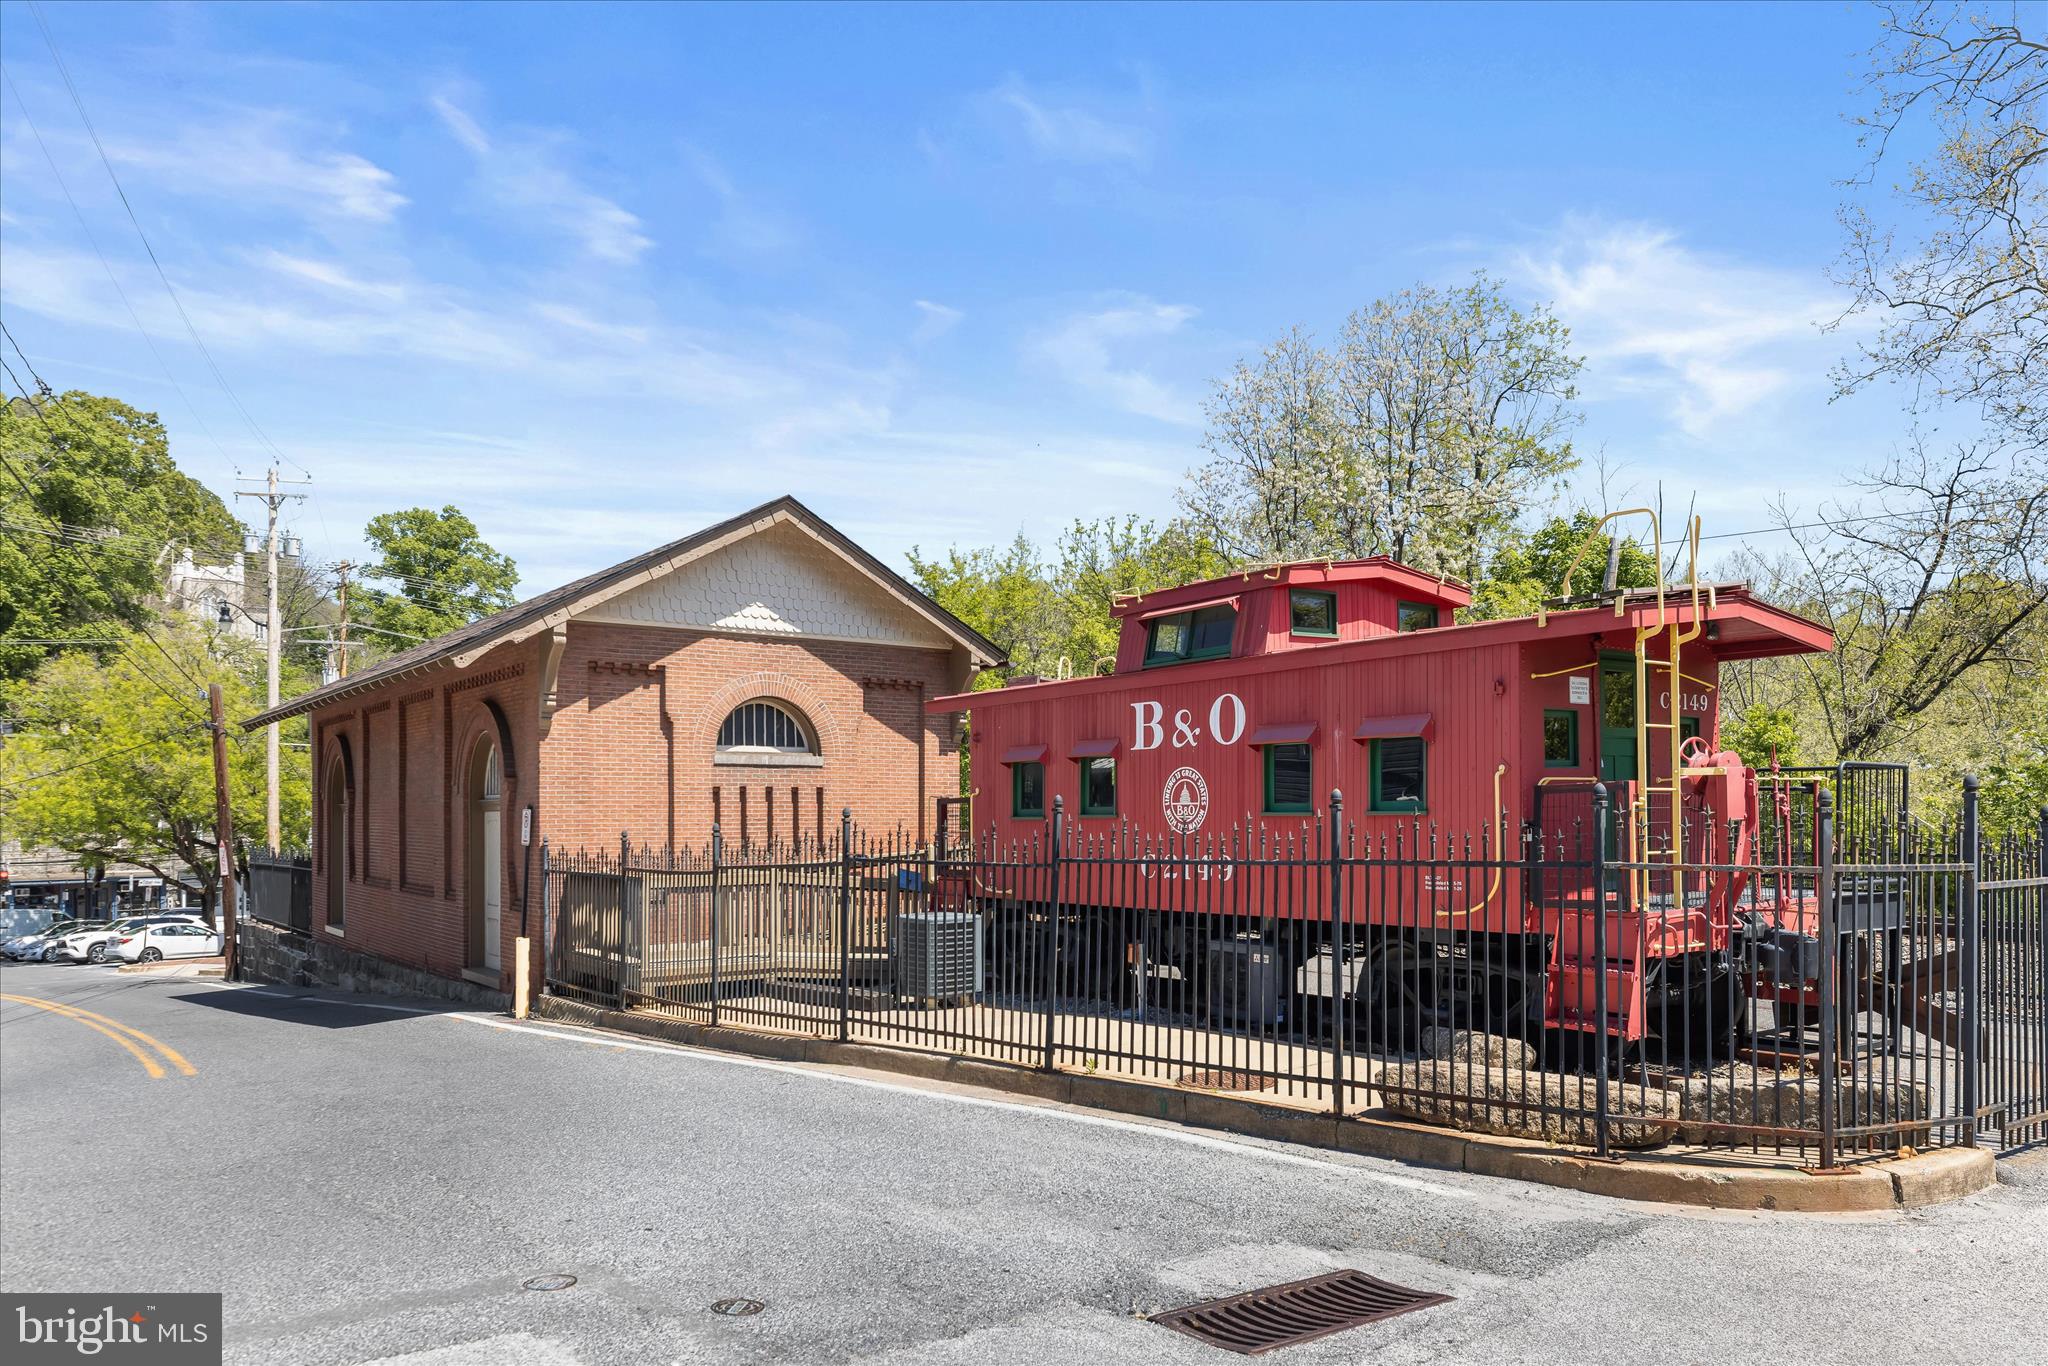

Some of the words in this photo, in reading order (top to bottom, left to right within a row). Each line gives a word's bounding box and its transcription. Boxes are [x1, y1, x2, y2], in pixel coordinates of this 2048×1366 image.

[1660, 692, 1708, 711] C149
[1164, 777, 1177, 806] LINKING
[1181, 769, 1199, 782] GREAT
[1197, 780, 1207, 806] STATES
[1166, 808, 1178, 827] WITH
[1188, 809, 1205, 831] NATION
[1177, 805, 1195, 816] B&O
